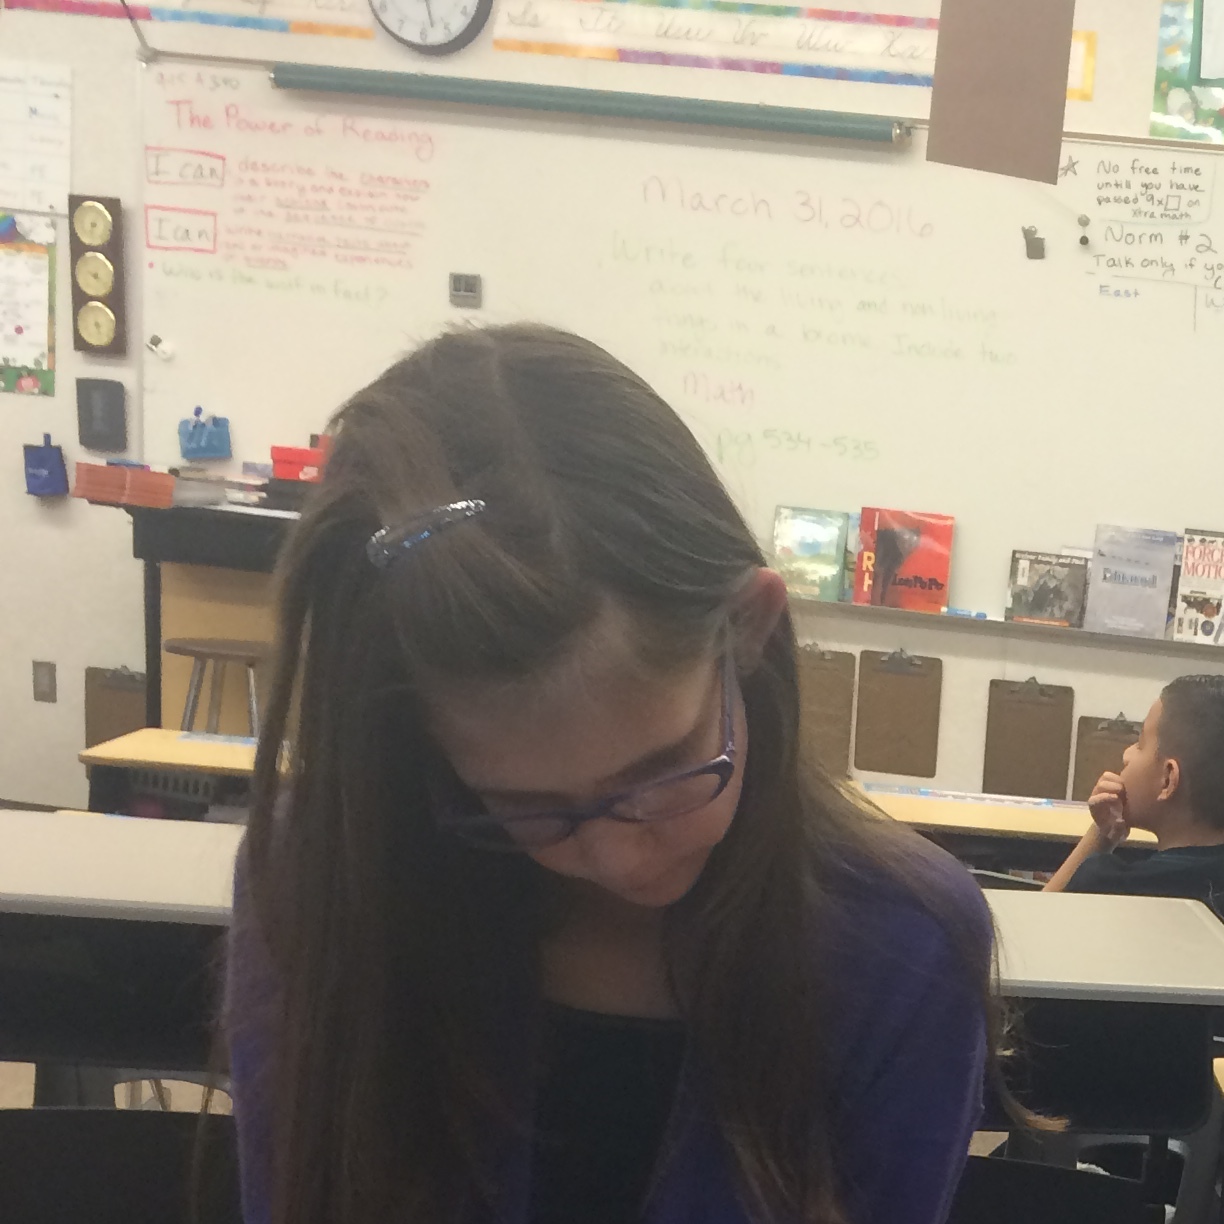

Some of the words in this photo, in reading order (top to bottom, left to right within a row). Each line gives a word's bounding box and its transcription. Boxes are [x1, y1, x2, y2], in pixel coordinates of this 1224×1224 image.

[166, 98, 214, 130] The
[224, 102, 293, 135] Power
[303, 122, 325, 137] of
[341, 115, 435, 162] Reading
[150, 153, 170, 177] I
[178, 162, 221, 181] can
[1097, 160, 1120, 175] No
[1131, 158, 1160, 175] free
[1170, 161, 1202, 177] time
[642, 174, 775, 223] March
[1140, 181, 1162, 197] you
[1169, 179, 1206, 193] have
[1186, 199, 1201, 208] on
[153, 216, 171, 241] I
[172, 224, 212, 243] can
[1104, 223, 1164, 246] Norm
[610, 228, 697, 269] Write
[1092, 254, 1136, 269] Talk
[1140, 256, 1176, 278] only
[1098, 284, 1141, 298] East
[855, 296, 888, 315] and
